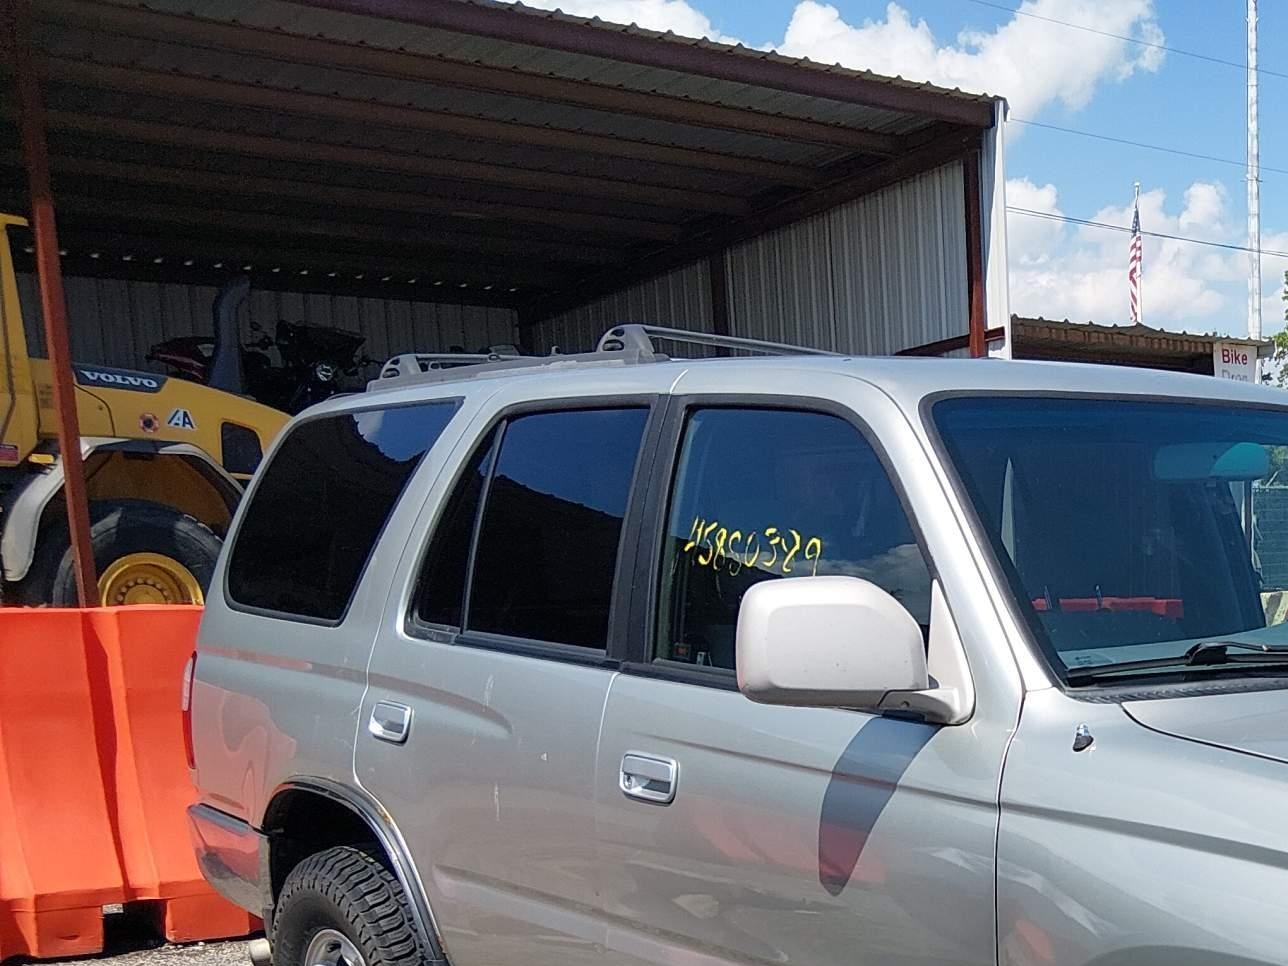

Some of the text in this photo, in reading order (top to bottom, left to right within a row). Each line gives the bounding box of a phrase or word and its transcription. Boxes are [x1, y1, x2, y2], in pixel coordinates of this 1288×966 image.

[1222, 349, 1248, 366] Bike
[80, 369, 158, 388] VOLVO
[684, 515, 822, 577] 45880389
